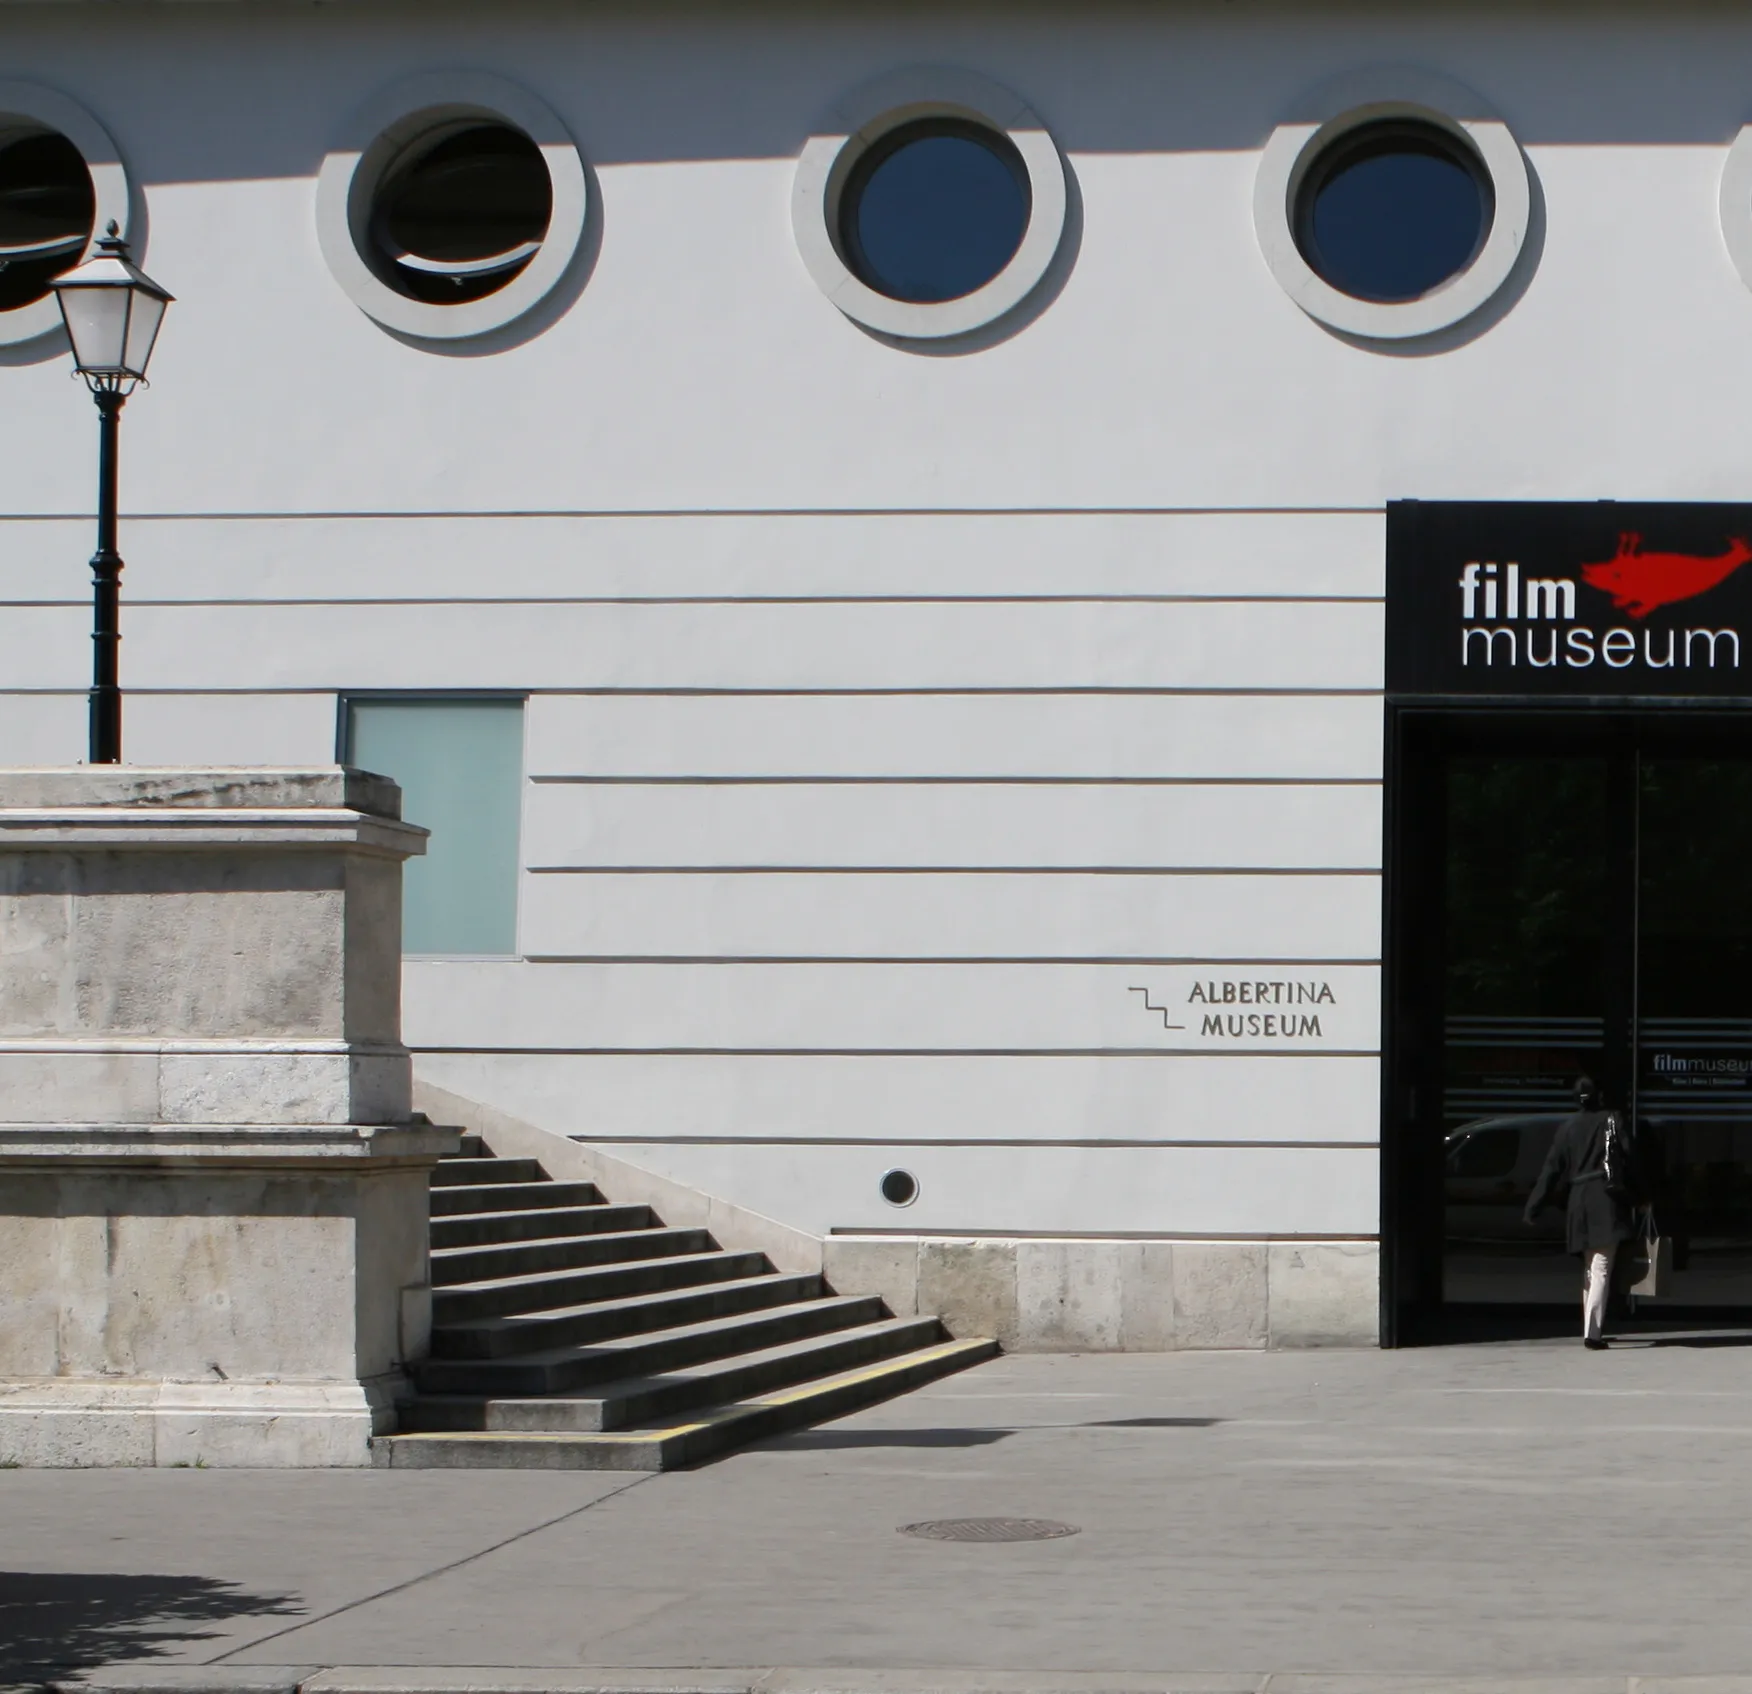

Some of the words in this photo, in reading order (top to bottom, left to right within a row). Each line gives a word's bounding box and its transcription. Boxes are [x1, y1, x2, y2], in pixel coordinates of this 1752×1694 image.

[1459, 563, 1576, 619] film
[1462, 627, 1741, 668] museum
[1188, 981, 1337, 1004] ALBERTINA
[1200, 1014, 1323, 1037] MUSEUM
